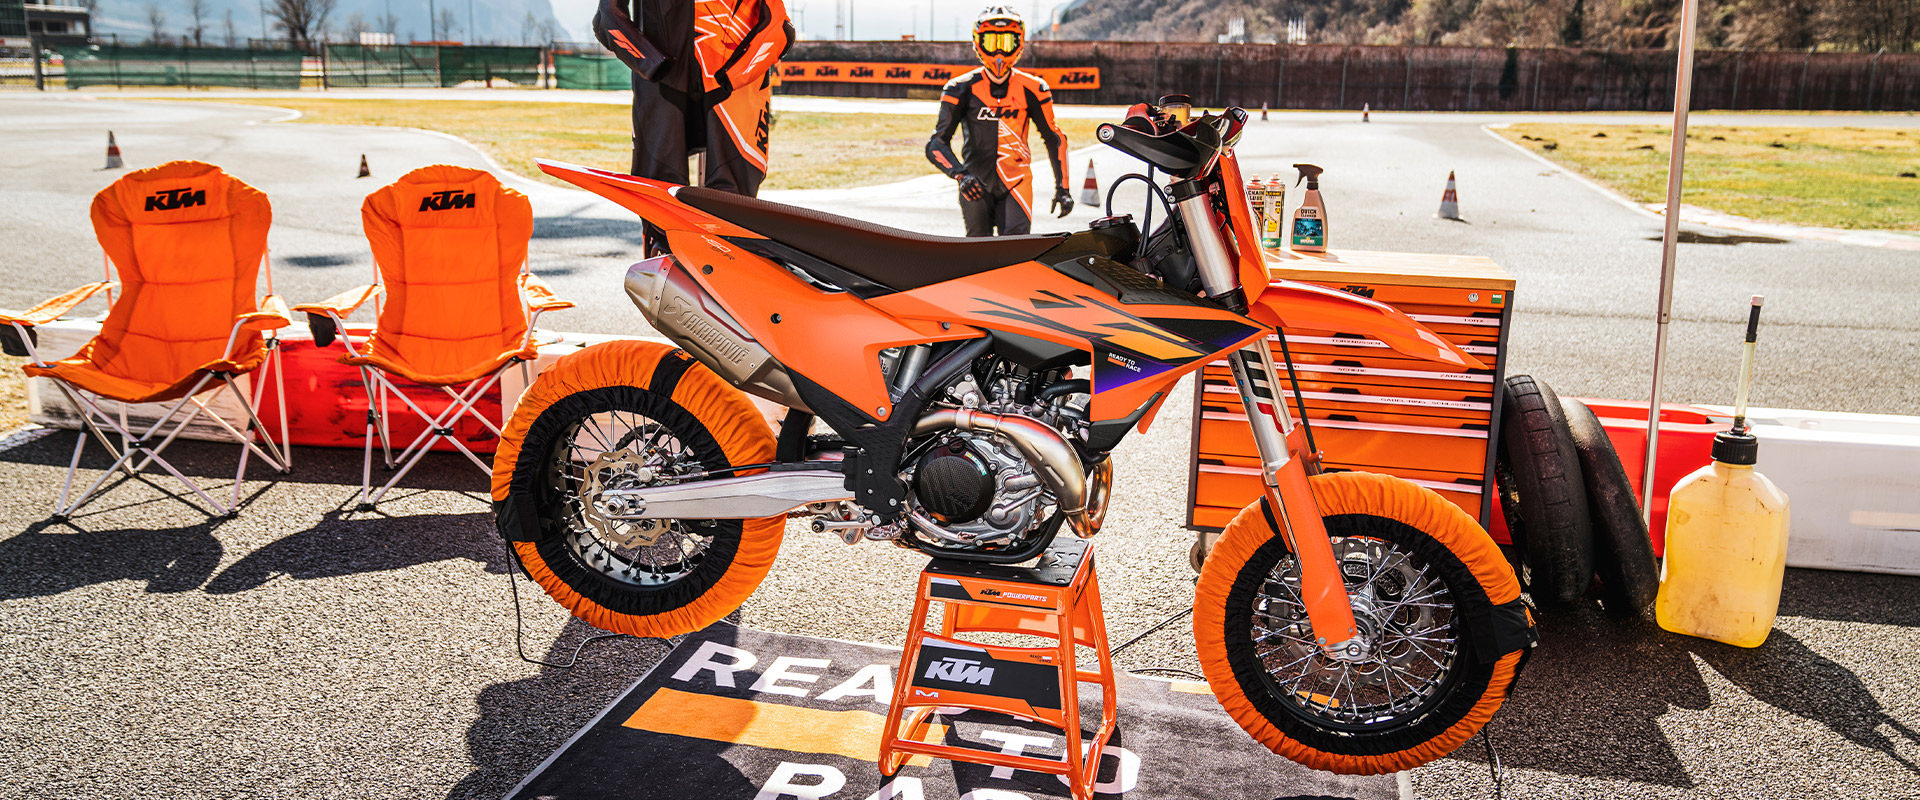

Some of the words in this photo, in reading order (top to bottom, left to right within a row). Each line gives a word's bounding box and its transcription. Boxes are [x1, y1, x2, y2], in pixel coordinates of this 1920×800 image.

[816, 66, 838, 77] KTM
[850, 66, 873, 78] KTM
[885, 67, 911, 79] KTM
[922, 68, 951, 80] KTM
[1059, 72, 1095, 84] KTM
[978, 105, 1019, 120] KTM
[144, 187, 206, 212] KTM
[418, 189, 476, 212] KTM
[1108, 352, 1127, 362] READY
[1127, 358, 1136, 366] TO
[1125, 363, 1142, 373] RACE
[980, 587, 1001, 597] KTM
[924, 656, 995, 686] KTM
